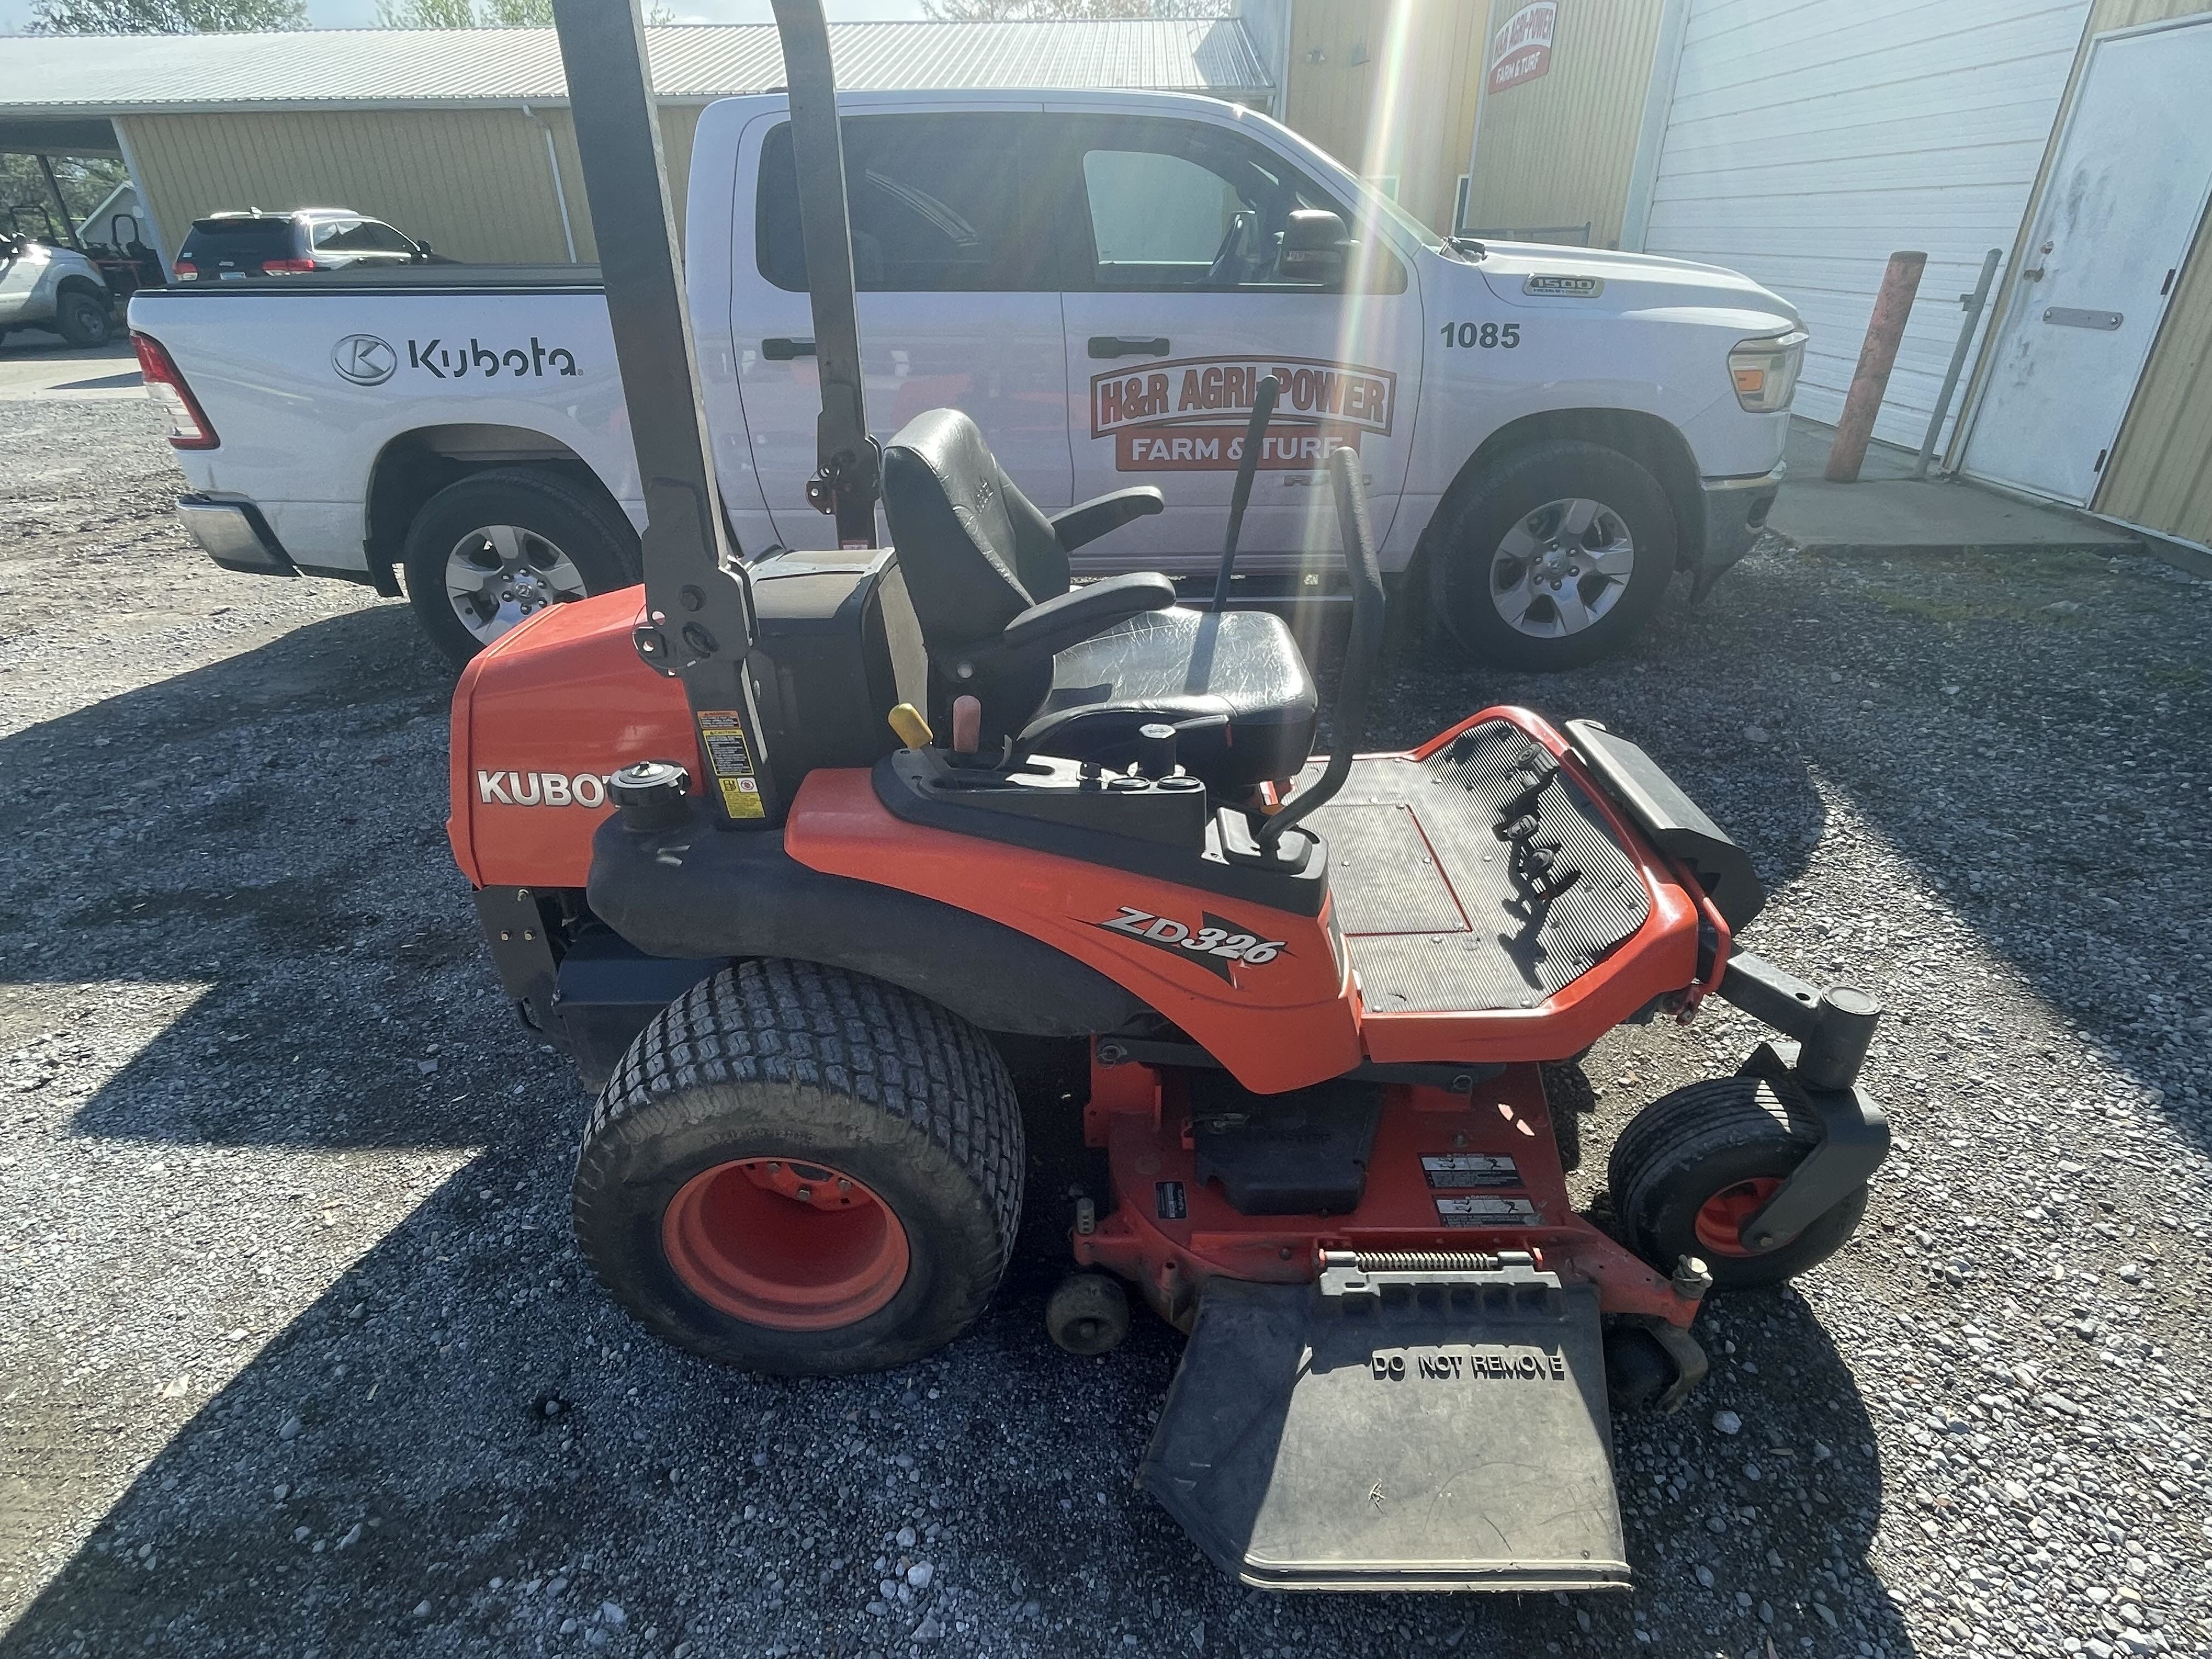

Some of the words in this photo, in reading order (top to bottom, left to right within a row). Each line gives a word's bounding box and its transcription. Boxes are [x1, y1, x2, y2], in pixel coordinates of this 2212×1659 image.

[1496, 61, 1515, 84] FARM
[1514, 60, 1521, 77] &
[1521, 52, 1541, 75] TURF
[1536, 278, 1592, 289] 1500
[1440, 321, 1520, 349] 1085
[408, 337, 577, 379] Kubota
[1100, 373, 1170, 425] H&R
[1132, 437, 1220, 461] FARM
[1227, 437, 1245, 461] &
[1262, 437, 1343, 460] TURF
[1102, 906, 1286, 964] ZD326
[1372, 1354, 1406, 1379] DO
[1419, 1354, 1463, 1379] NOT
[1471, 1354, 1565, 1379] REMOVE
